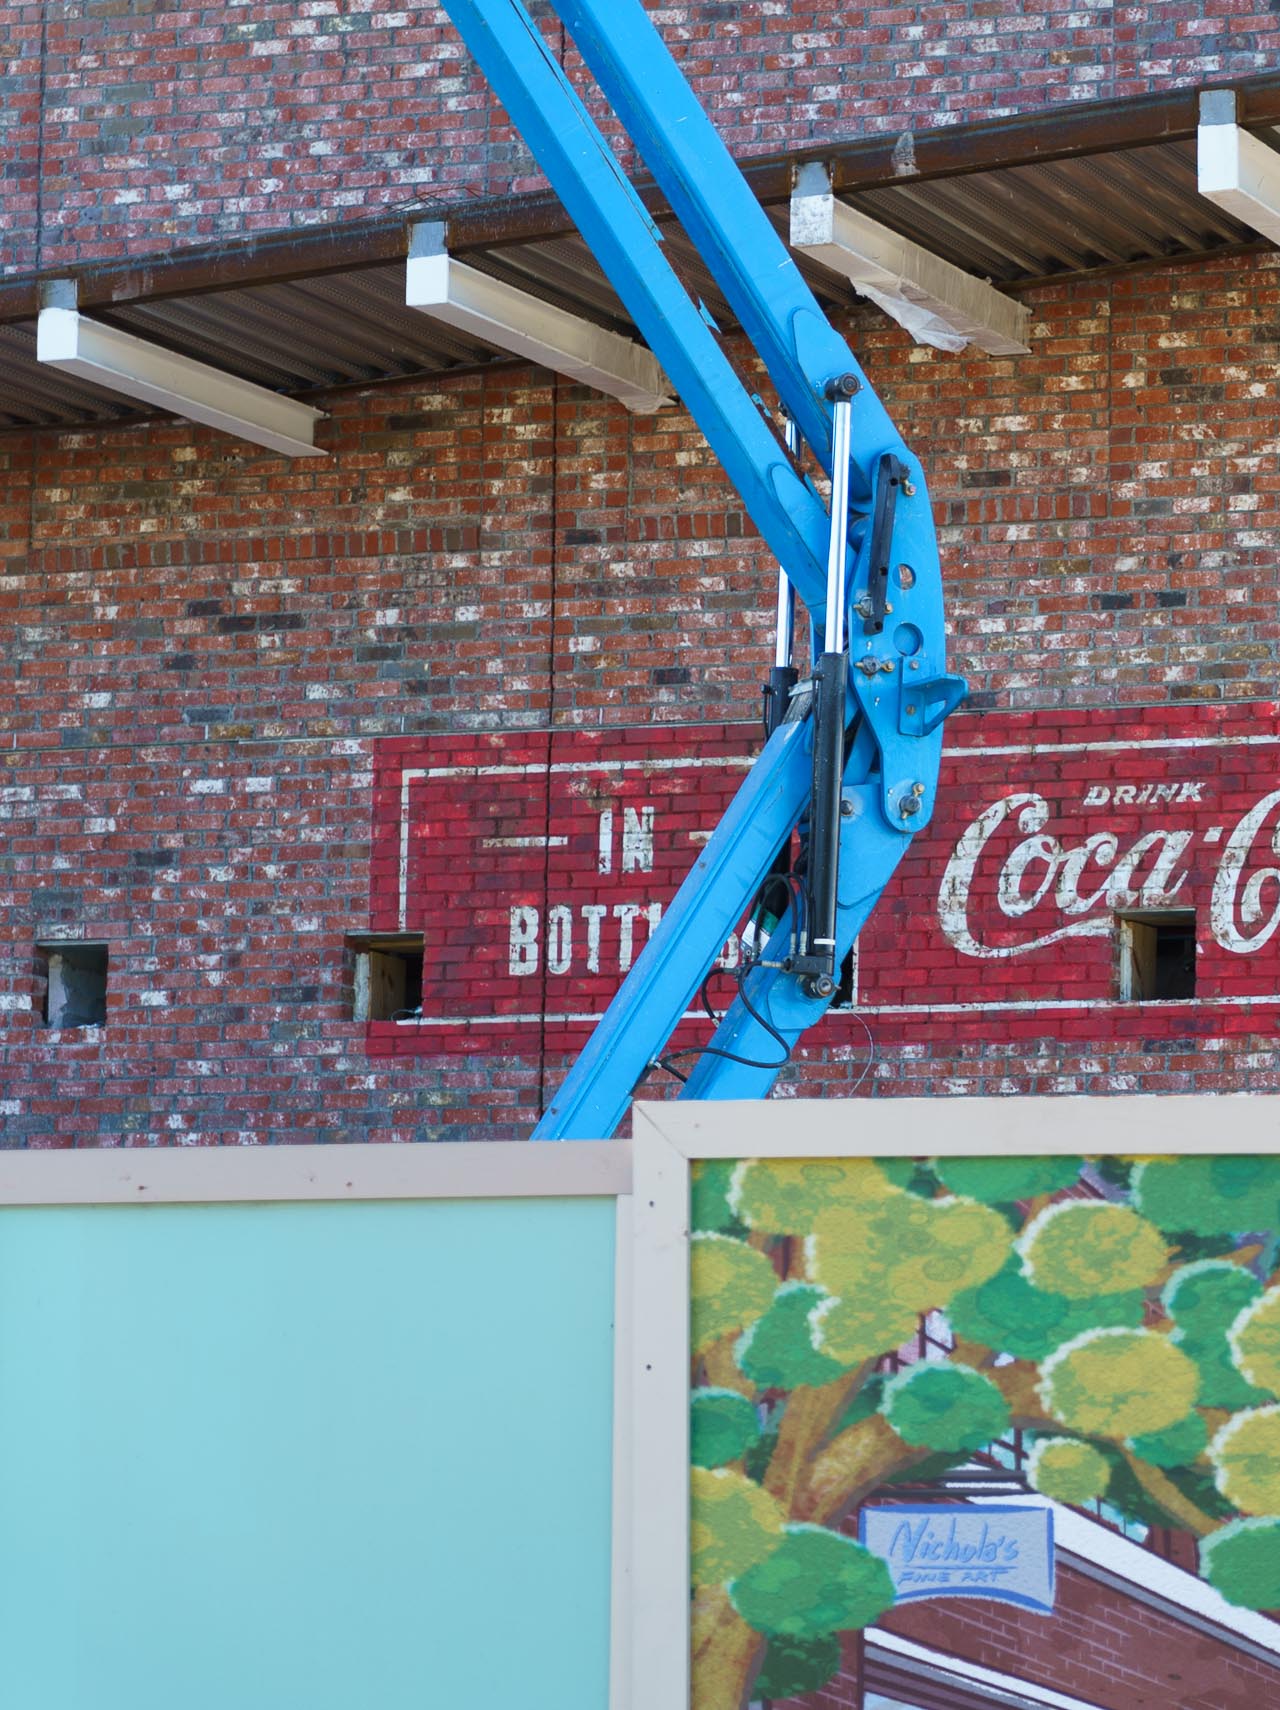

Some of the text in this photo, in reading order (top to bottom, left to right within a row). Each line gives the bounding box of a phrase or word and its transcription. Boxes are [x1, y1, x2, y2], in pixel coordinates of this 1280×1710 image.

[1083, 782, 1207, 807] DRINK
[599, 806, 655, 874] IN
[898, 1568, 1009, 1585] FINE ART
